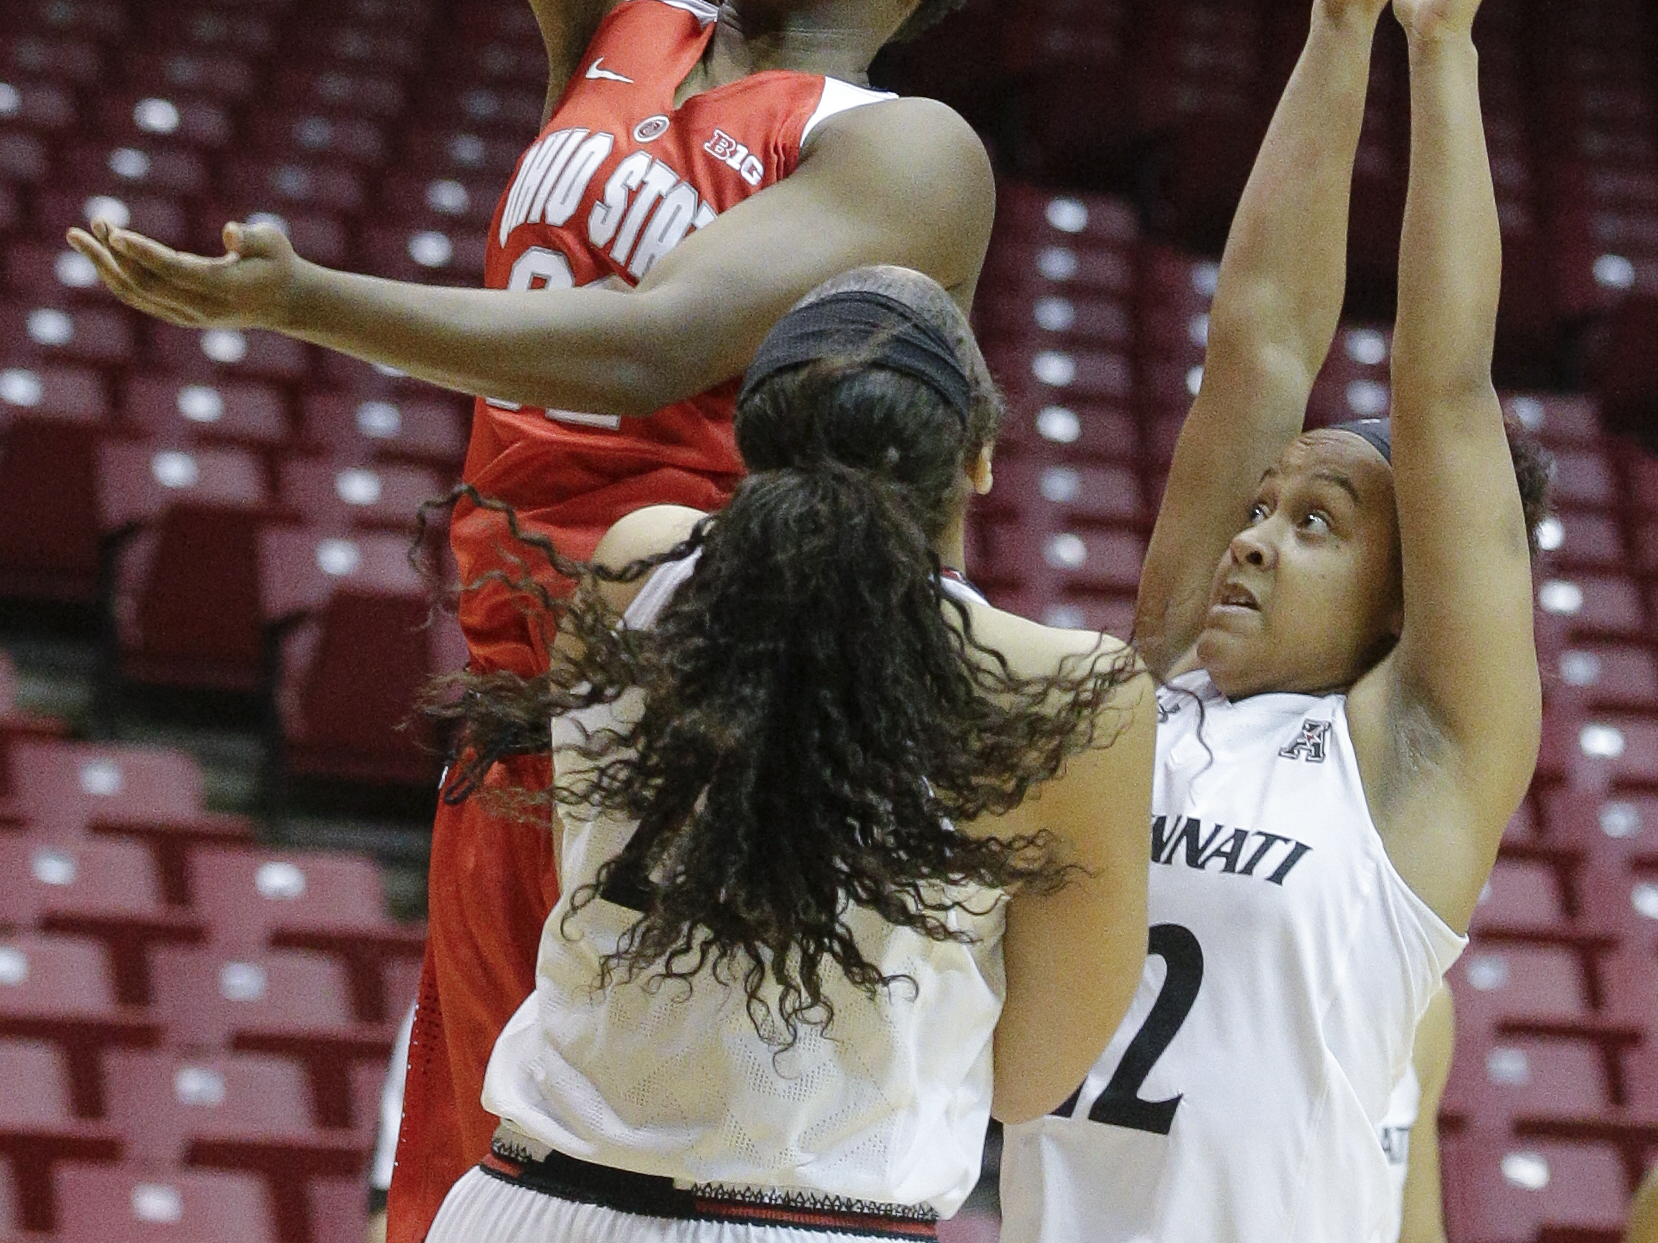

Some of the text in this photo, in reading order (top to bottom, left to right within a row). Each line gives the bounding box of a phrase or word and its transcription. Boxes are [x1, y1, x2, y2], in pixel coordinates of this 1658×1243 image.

[587, 150, 718, 280] STA
[1151, 813, 1313, 887] NNATI
[1050, 924, 1204, 1135] 2
